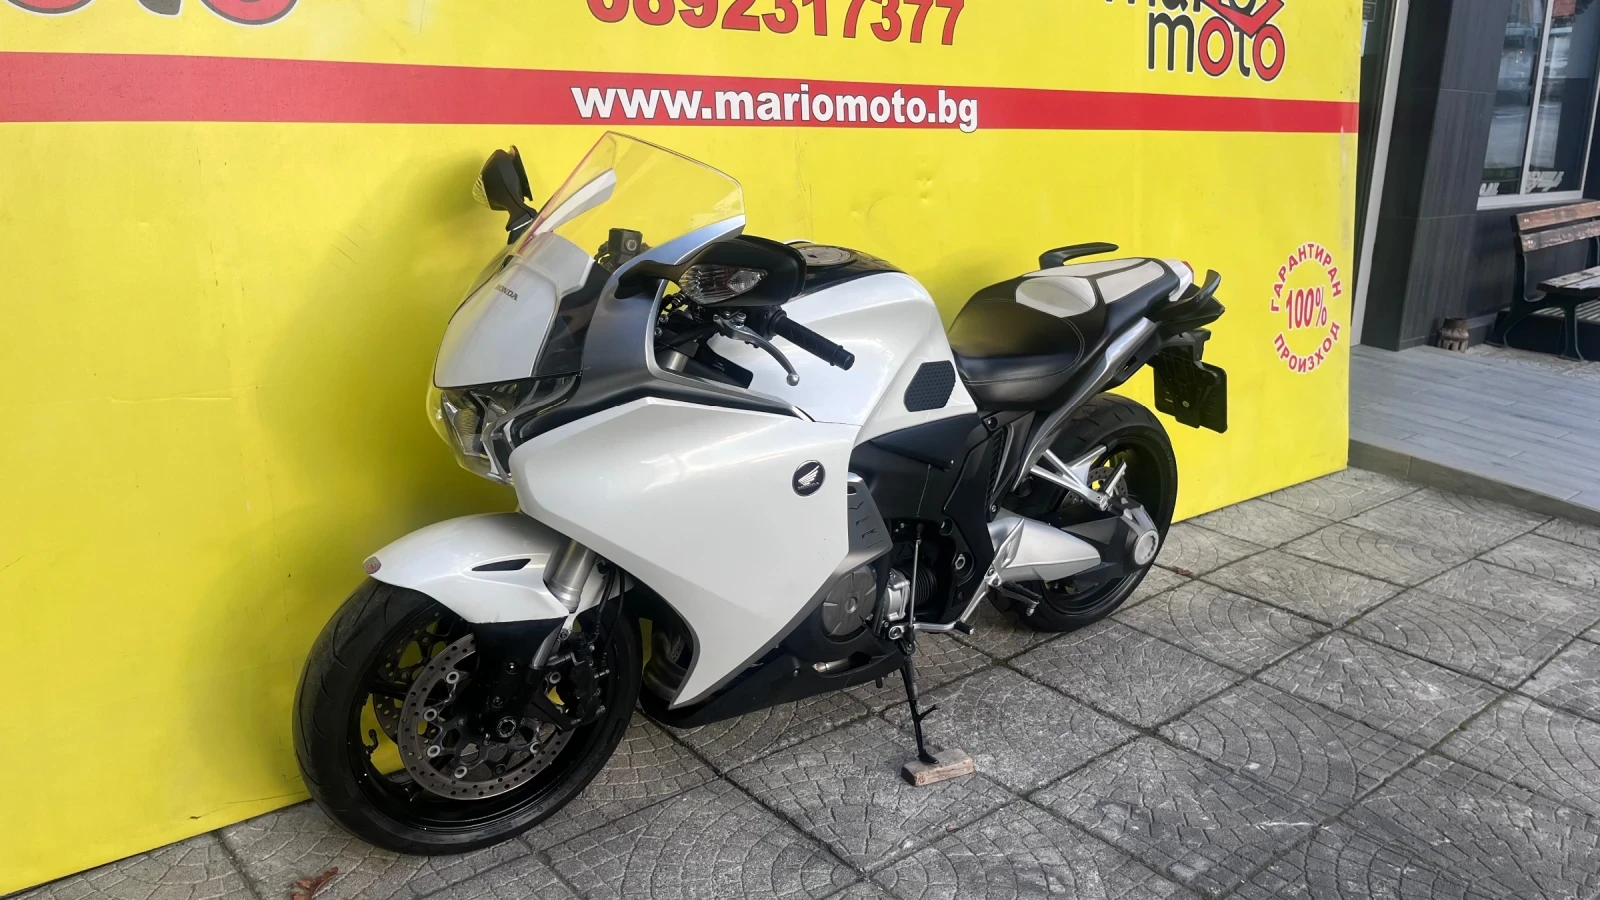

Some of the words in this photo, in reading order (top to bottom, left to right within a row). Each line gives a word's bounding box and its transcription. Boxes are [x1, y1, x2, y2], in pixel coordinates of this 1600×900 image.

[1147, 12, 1286, 82] moto
[570, 83, 978, 133] www.mariomoto.bg
[1270, 243, 1342, 312] ГАРАНТИРАН
[1285, 286, 1327, 330] 100%
[1273, 321, 1341, 373] ПРОИЗХОД
